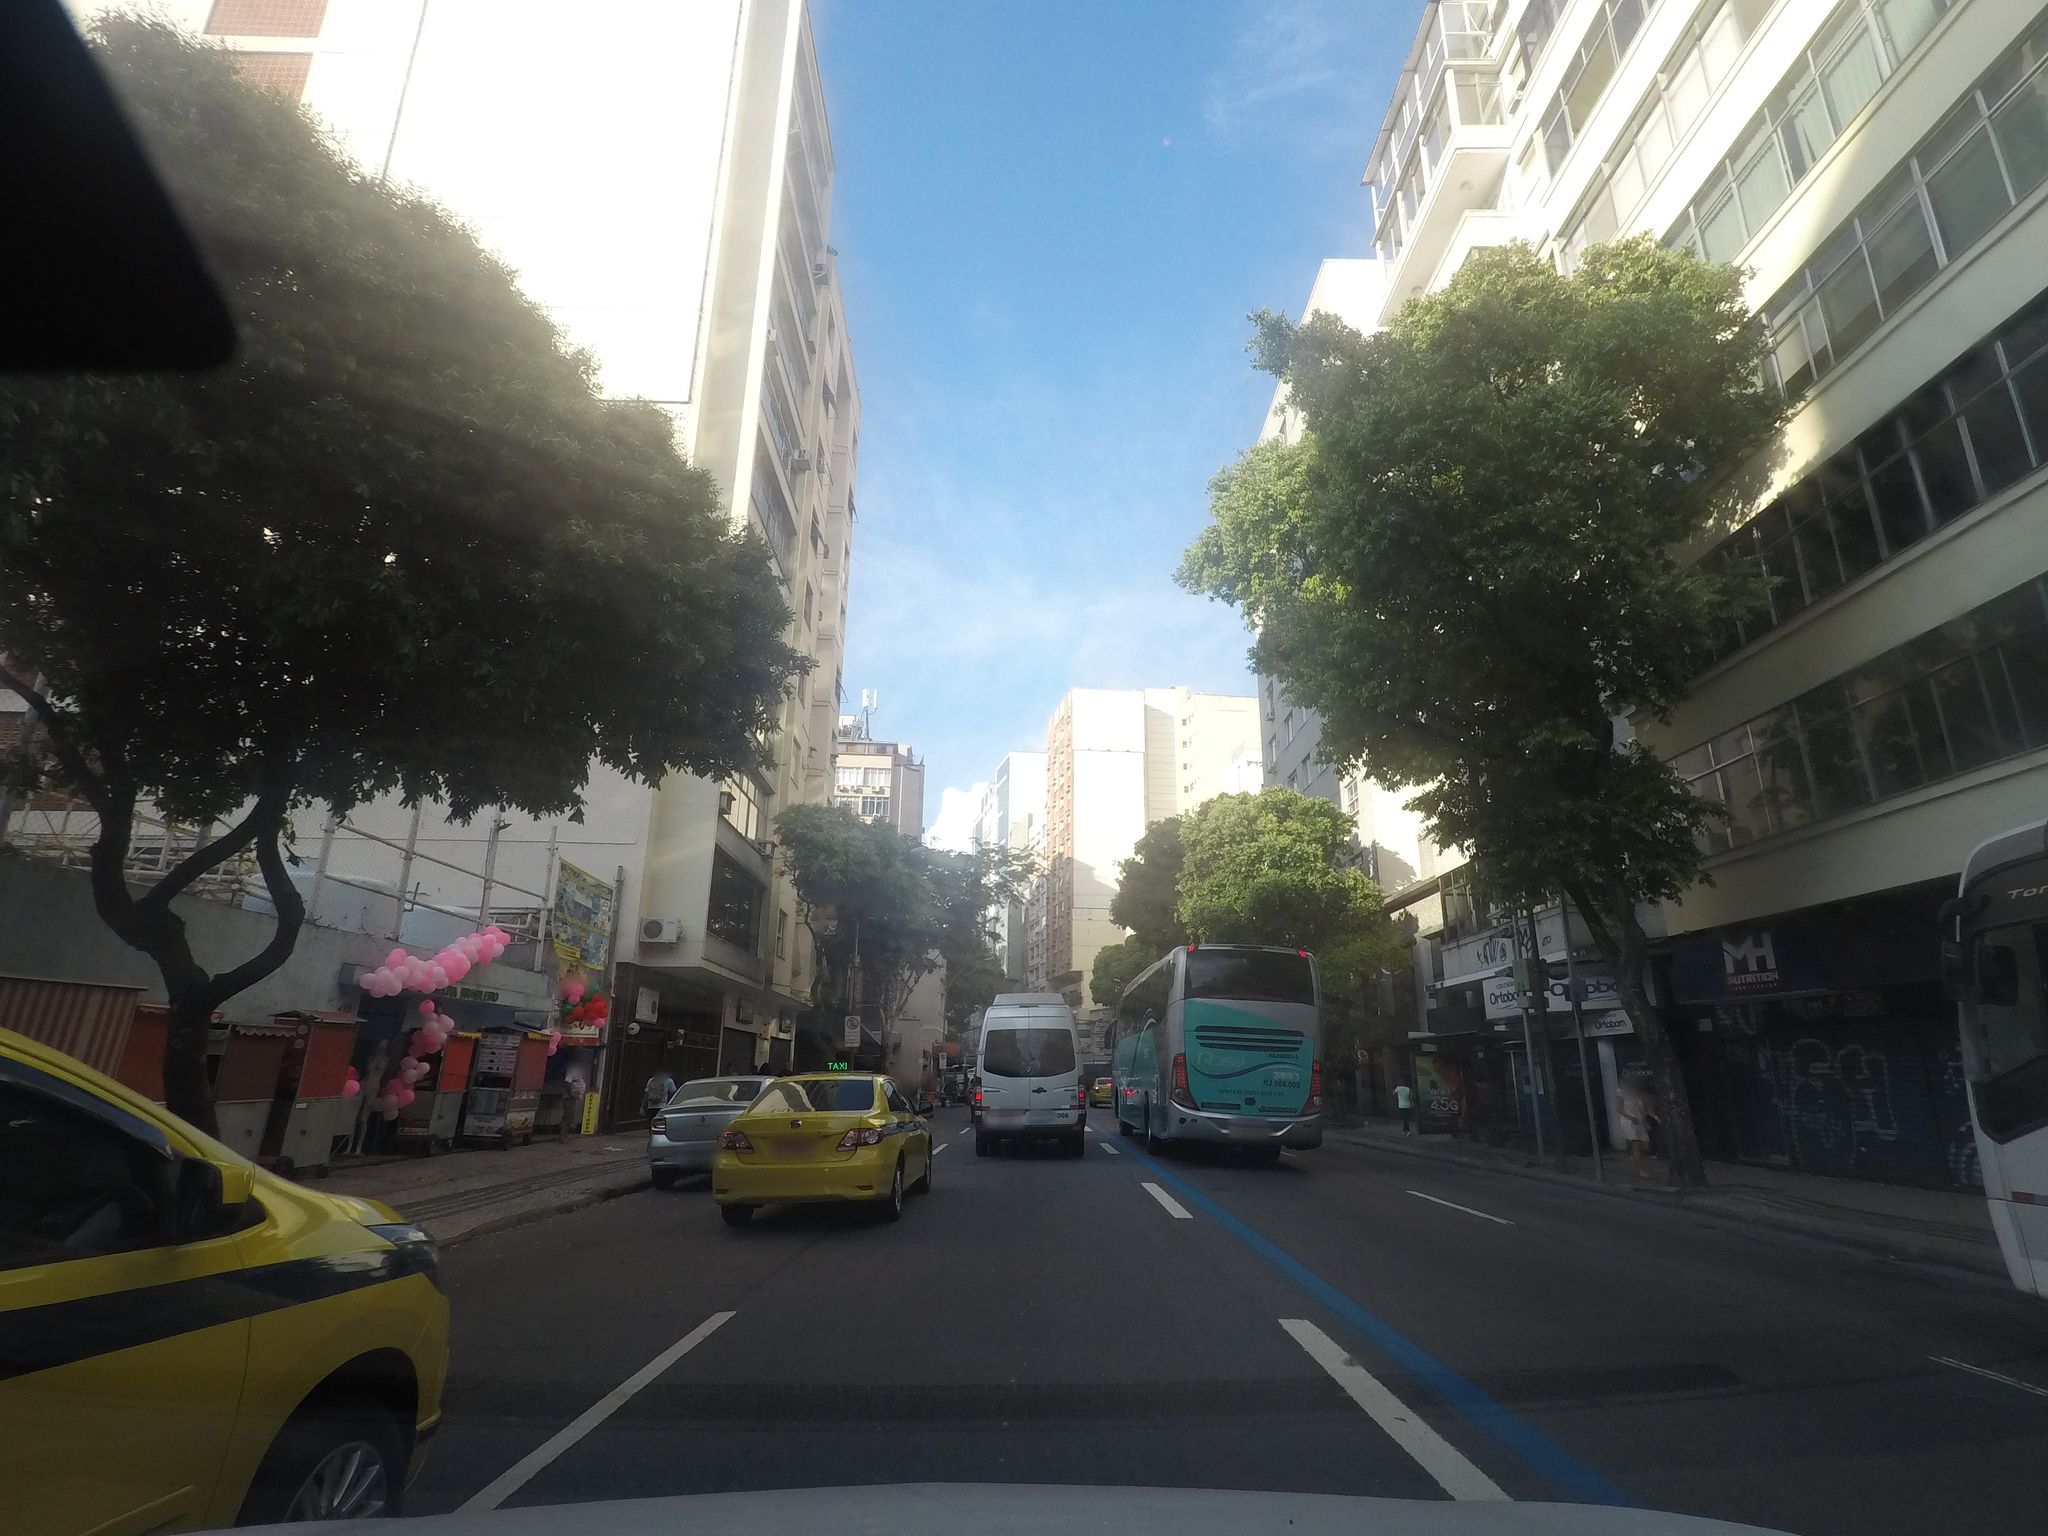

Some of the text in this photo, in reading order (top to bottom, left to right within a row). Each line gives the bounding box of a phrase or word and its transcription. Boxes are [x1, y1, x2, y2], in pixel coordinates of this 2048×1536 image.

[1721, 932, 1777, 975] MH
[1727, 970, 1779, 985] NUTRITION
[1489, 990, 1519, 1005] Ortobo
[1595, 1019, 1627, 1030] Ortobom
[827, 1062, 848, 1071] TAXI
